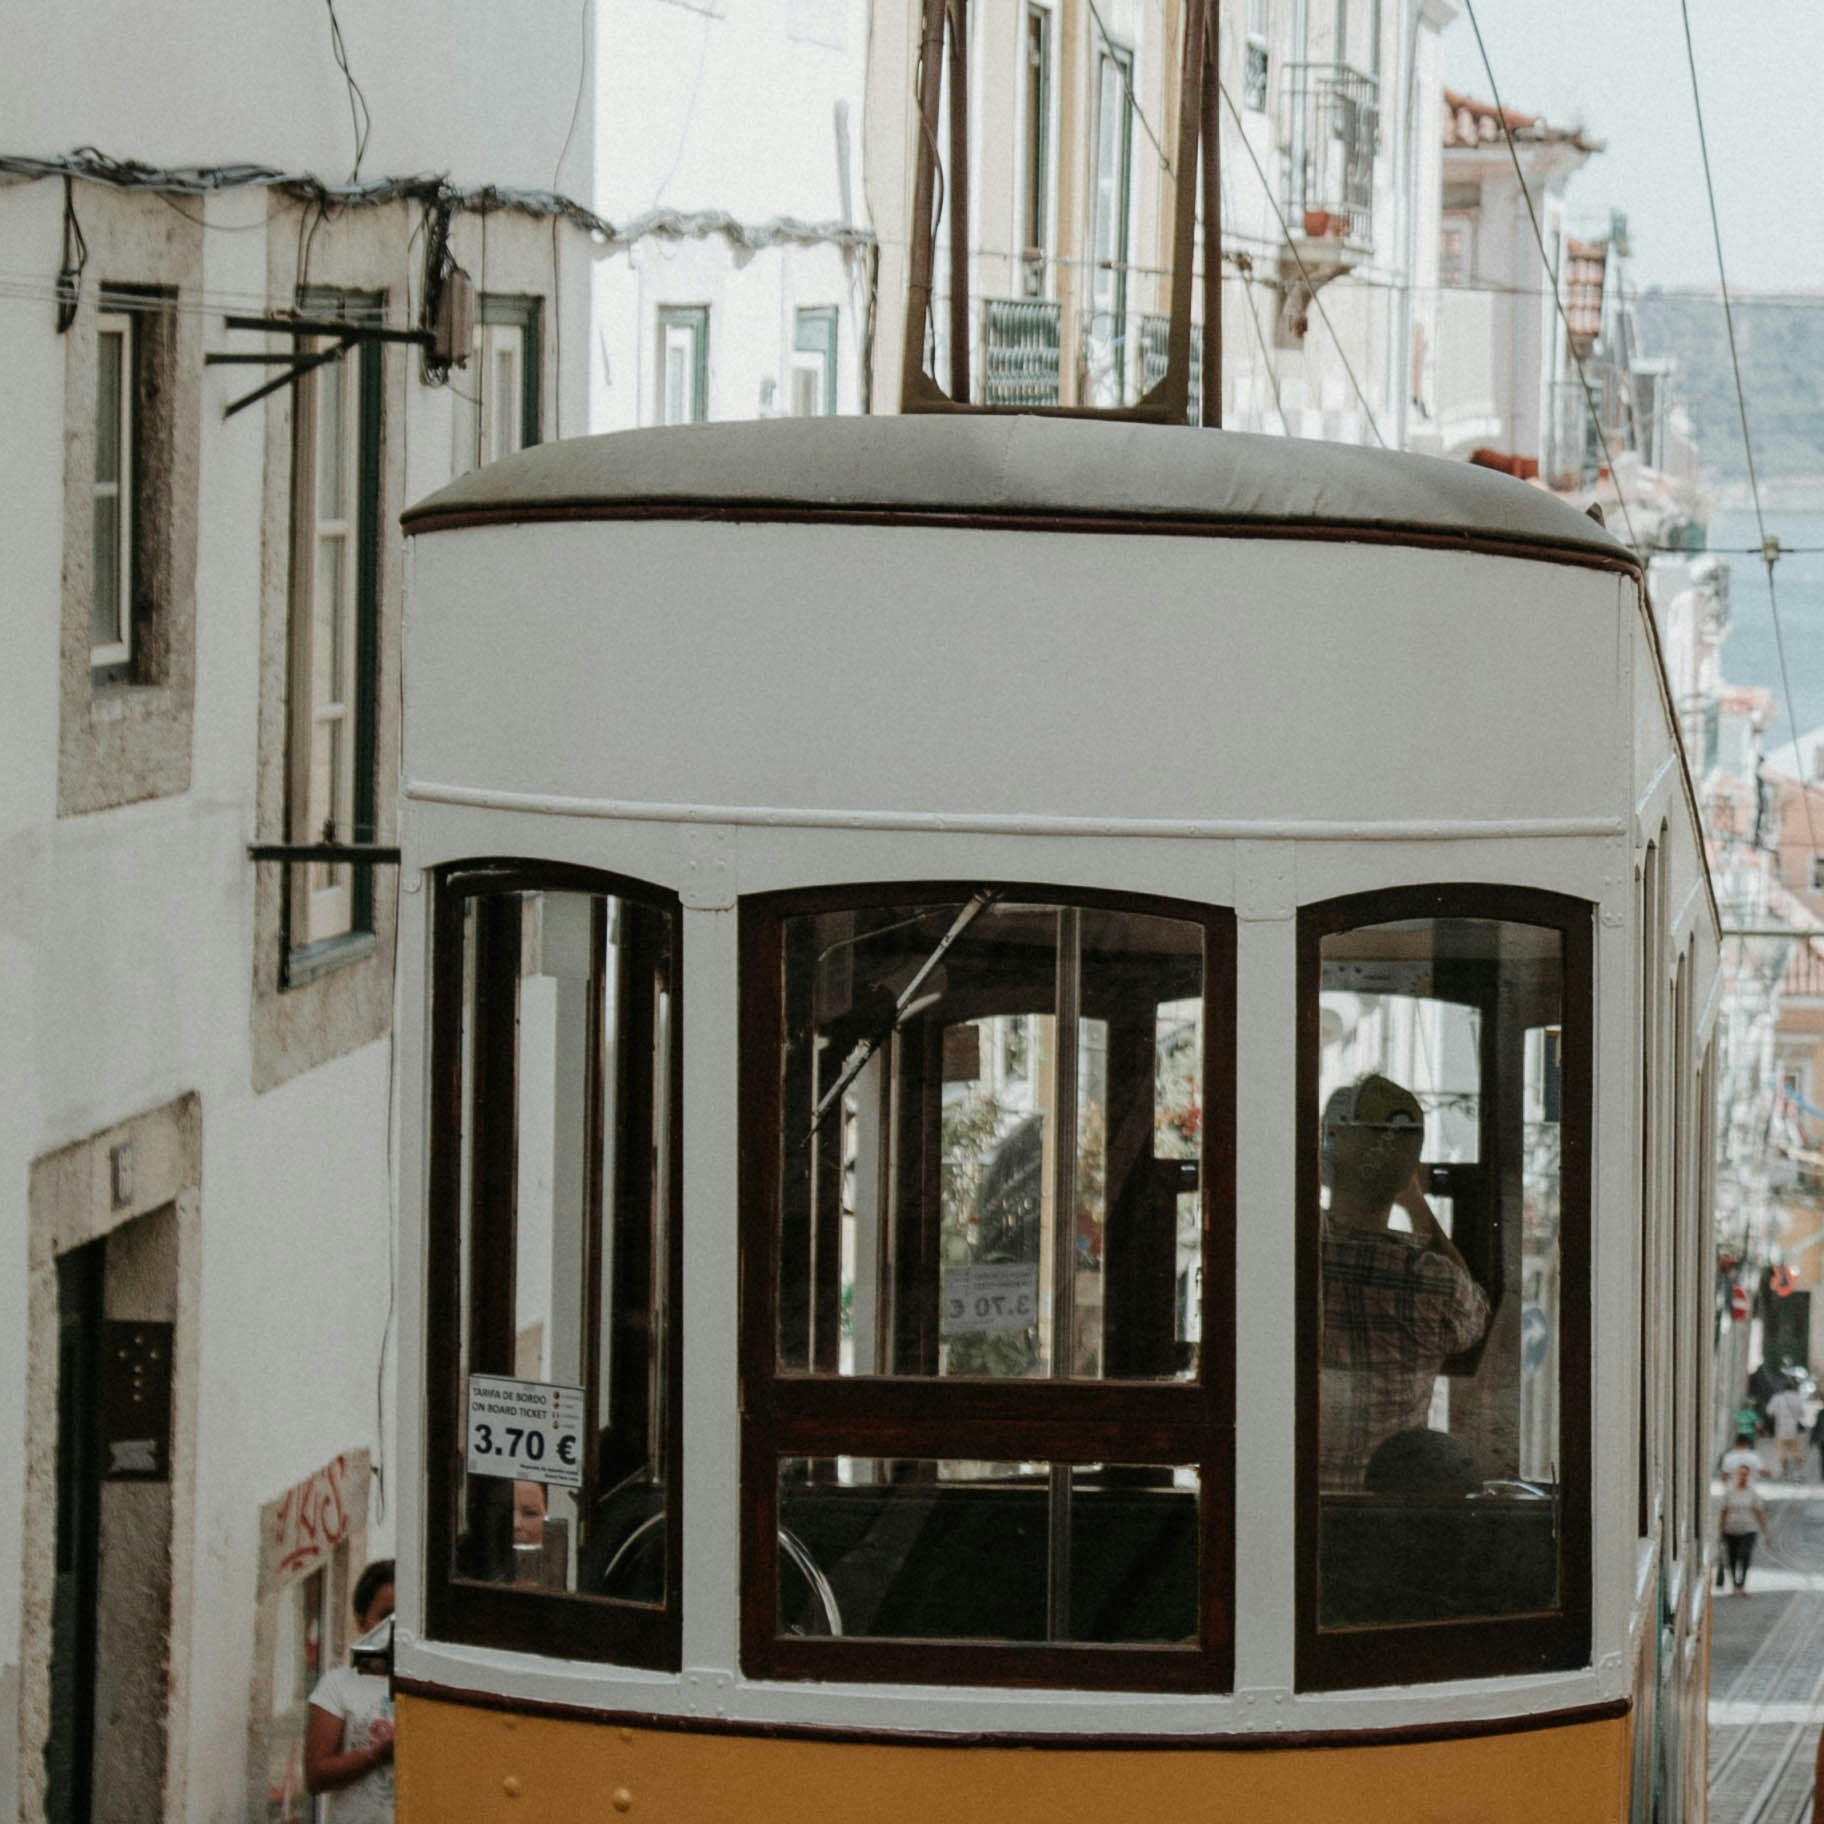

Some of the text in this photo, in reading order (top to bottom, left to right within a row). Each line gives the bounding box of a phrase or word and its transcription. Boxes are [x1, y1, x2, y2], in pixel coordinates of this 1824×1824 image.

[472, 1387, 547, 1405] TARIFA DE BORDO
[471, 1402, 547, 1419] ON BOARD TICKET
[473, 1423, 577, 1466] 3.70 €
